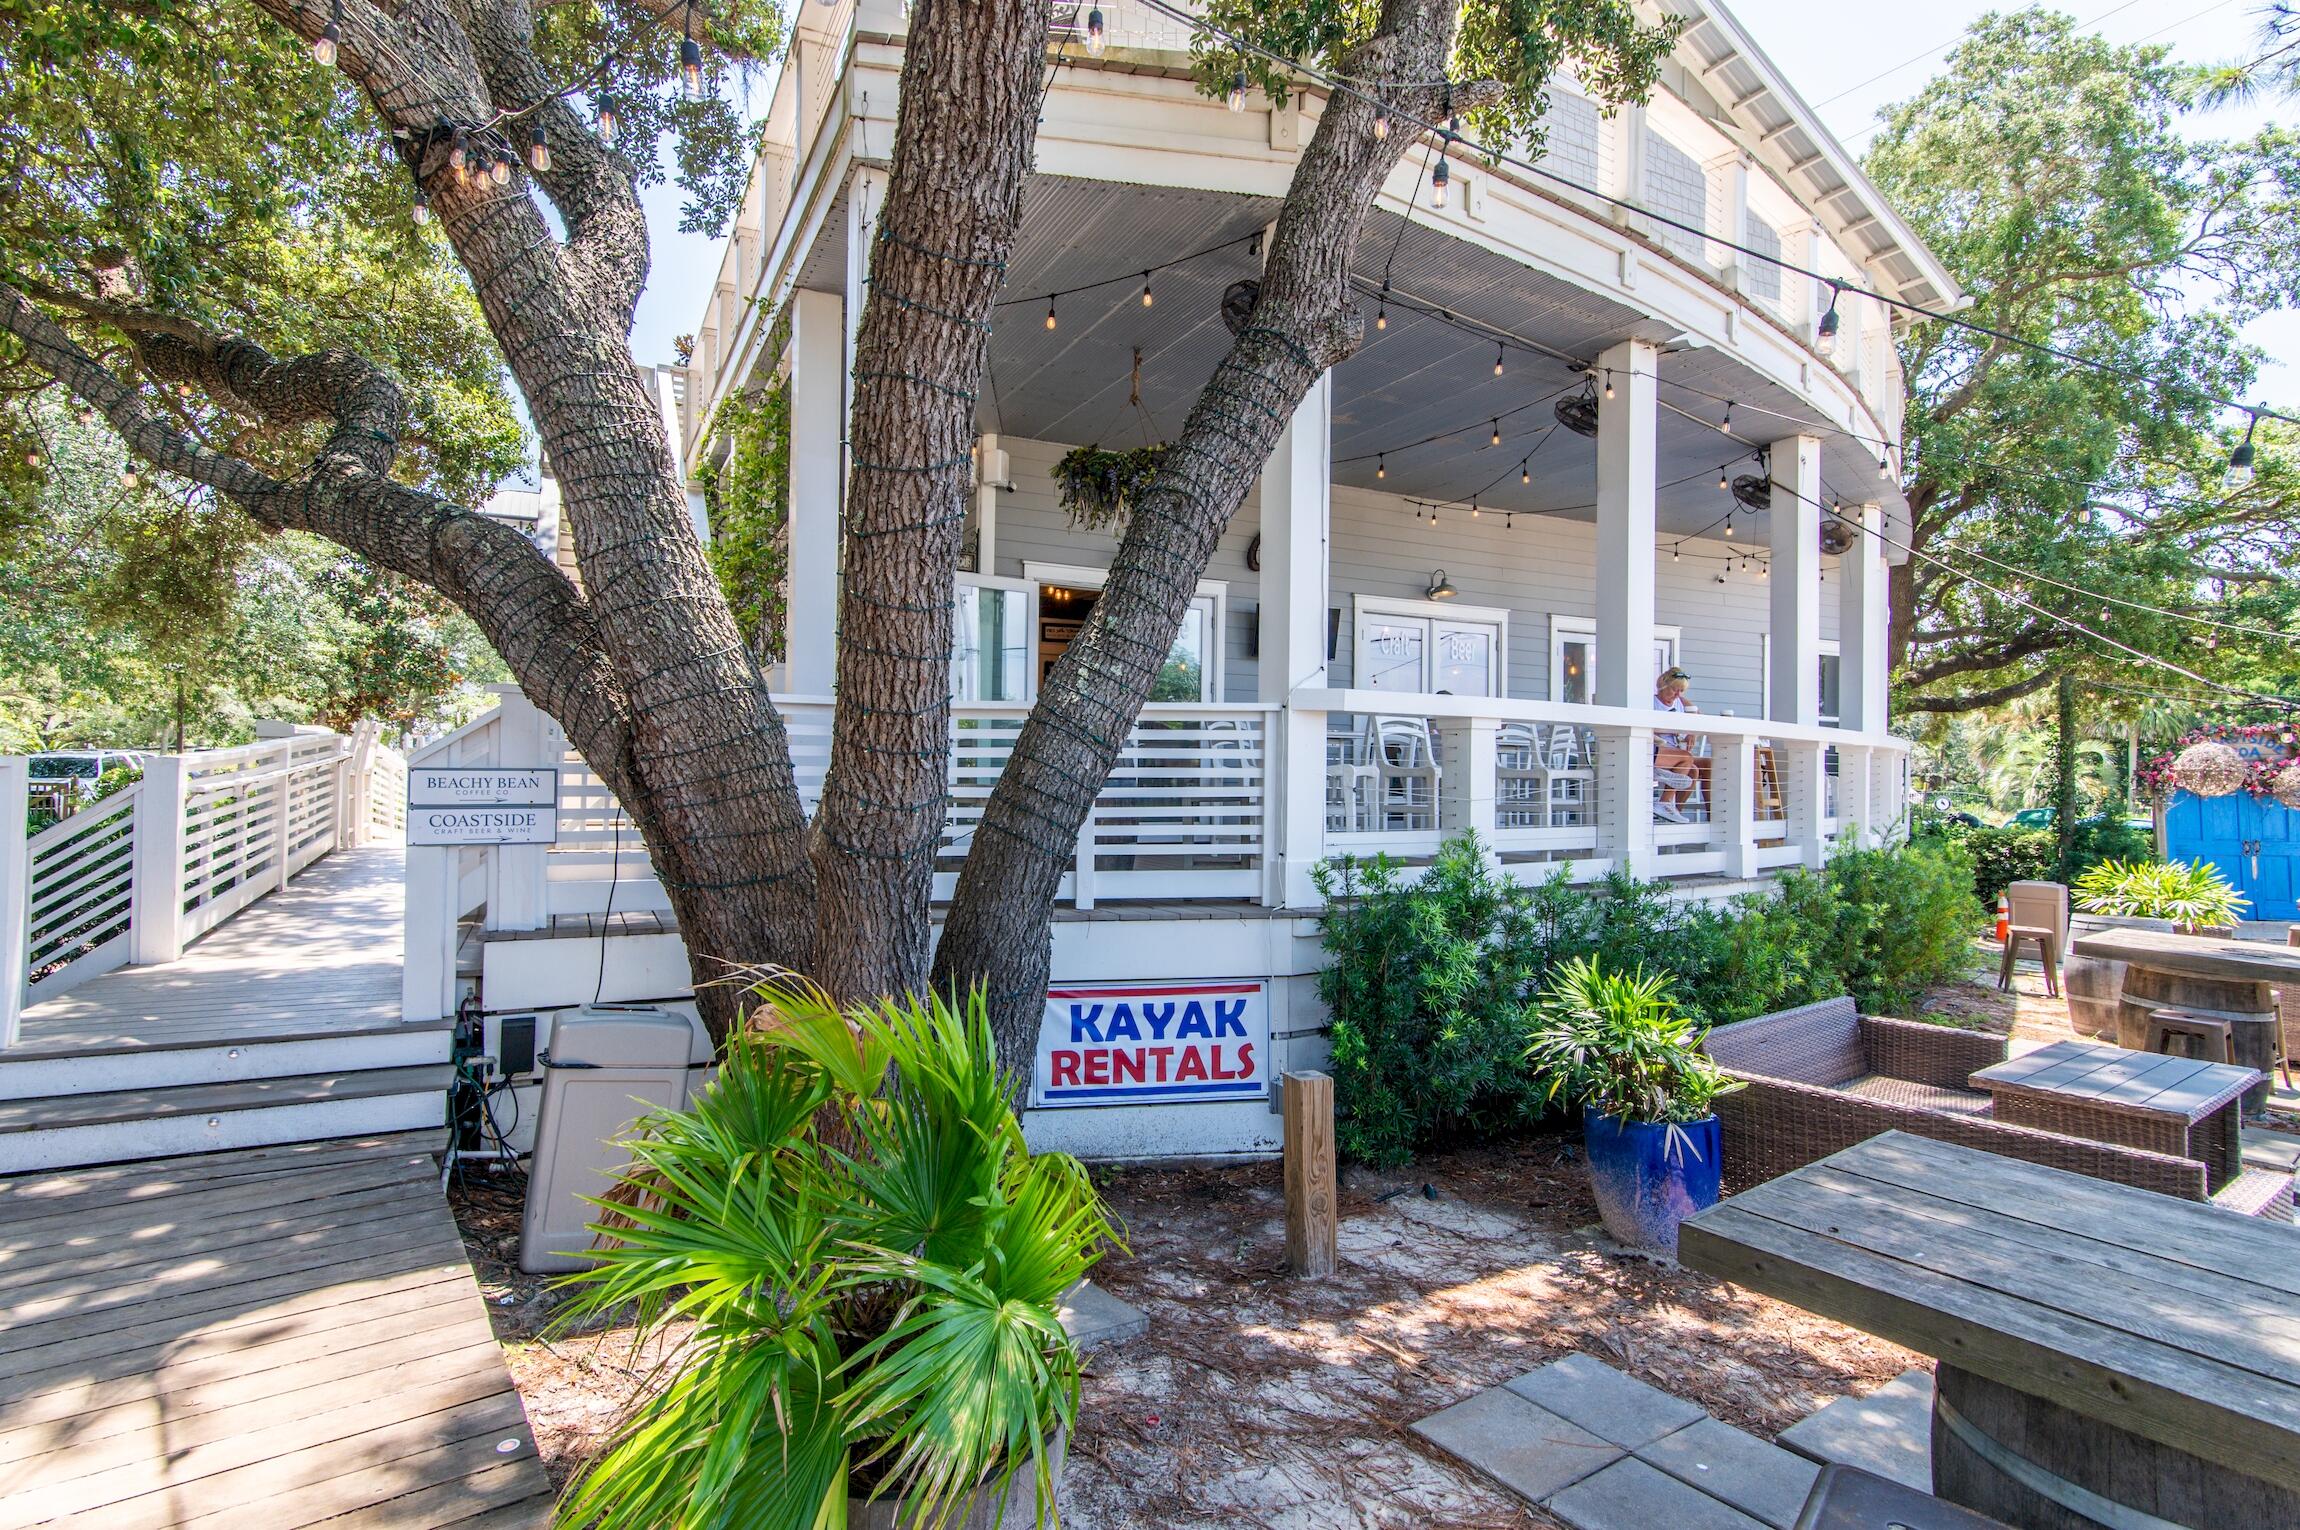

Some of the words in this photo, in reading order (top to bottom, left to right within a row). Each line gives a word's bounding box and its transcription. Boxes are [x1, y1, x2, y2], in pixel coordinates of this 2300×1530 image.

[1380, 630, 1411, 657] Craft
[1450, 636, 1475, 662] Beer
[427, 777, 493, 788] BEACHY
[497, 777, 540, 788] BEAN
[429, 814, 536, 828] COASTSIDE
[468, 827, 491, 835] BEER
[507, 826, 532, 834] WINE
[1070, 999, 1248, 1043] KAYAK
[1051, 1042, 1255, 1087] RENTALS
